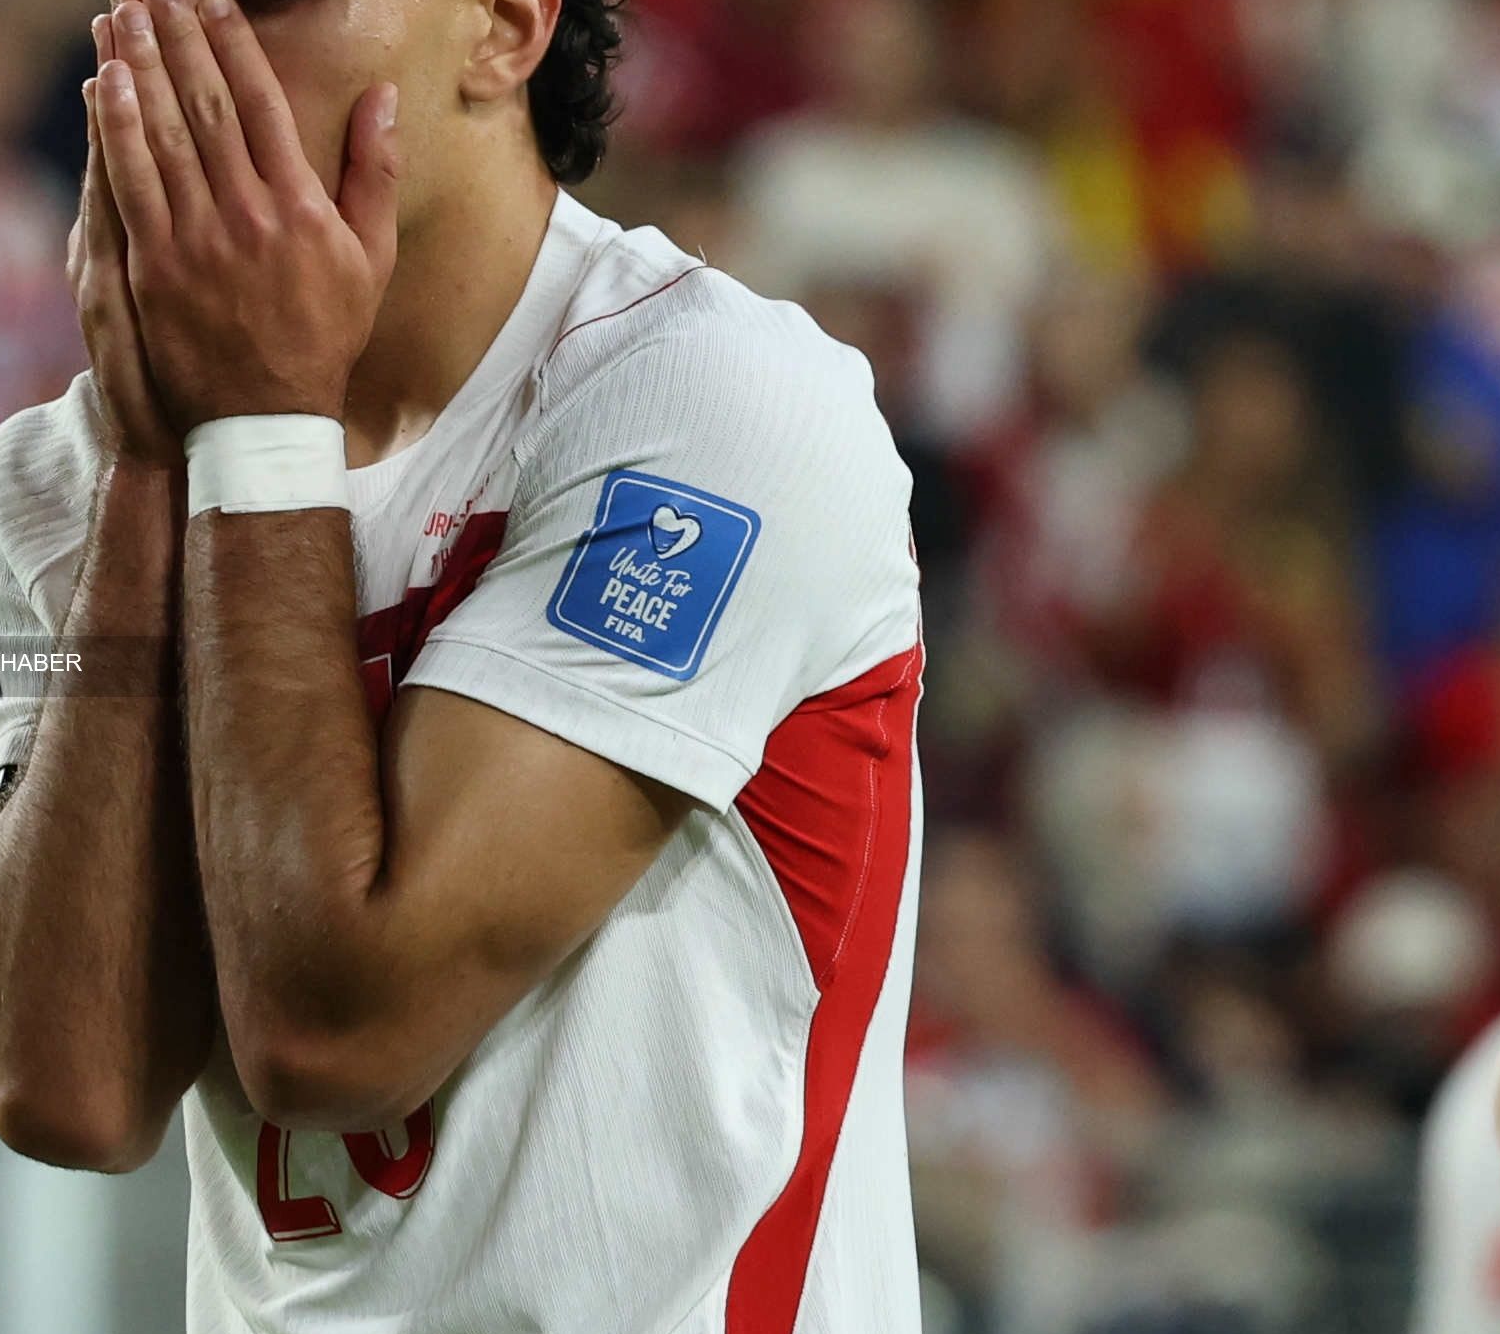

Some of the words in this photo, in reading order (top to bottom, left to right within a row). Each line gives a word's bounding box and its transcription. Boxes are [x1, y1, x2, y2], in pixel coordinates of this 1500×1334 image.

[609, 546, 663, 587] Unite
[661, 569, 693, 598] For
[599, 576, 678, 632] PEACE
[603, 614, 645, 644] FIFA
